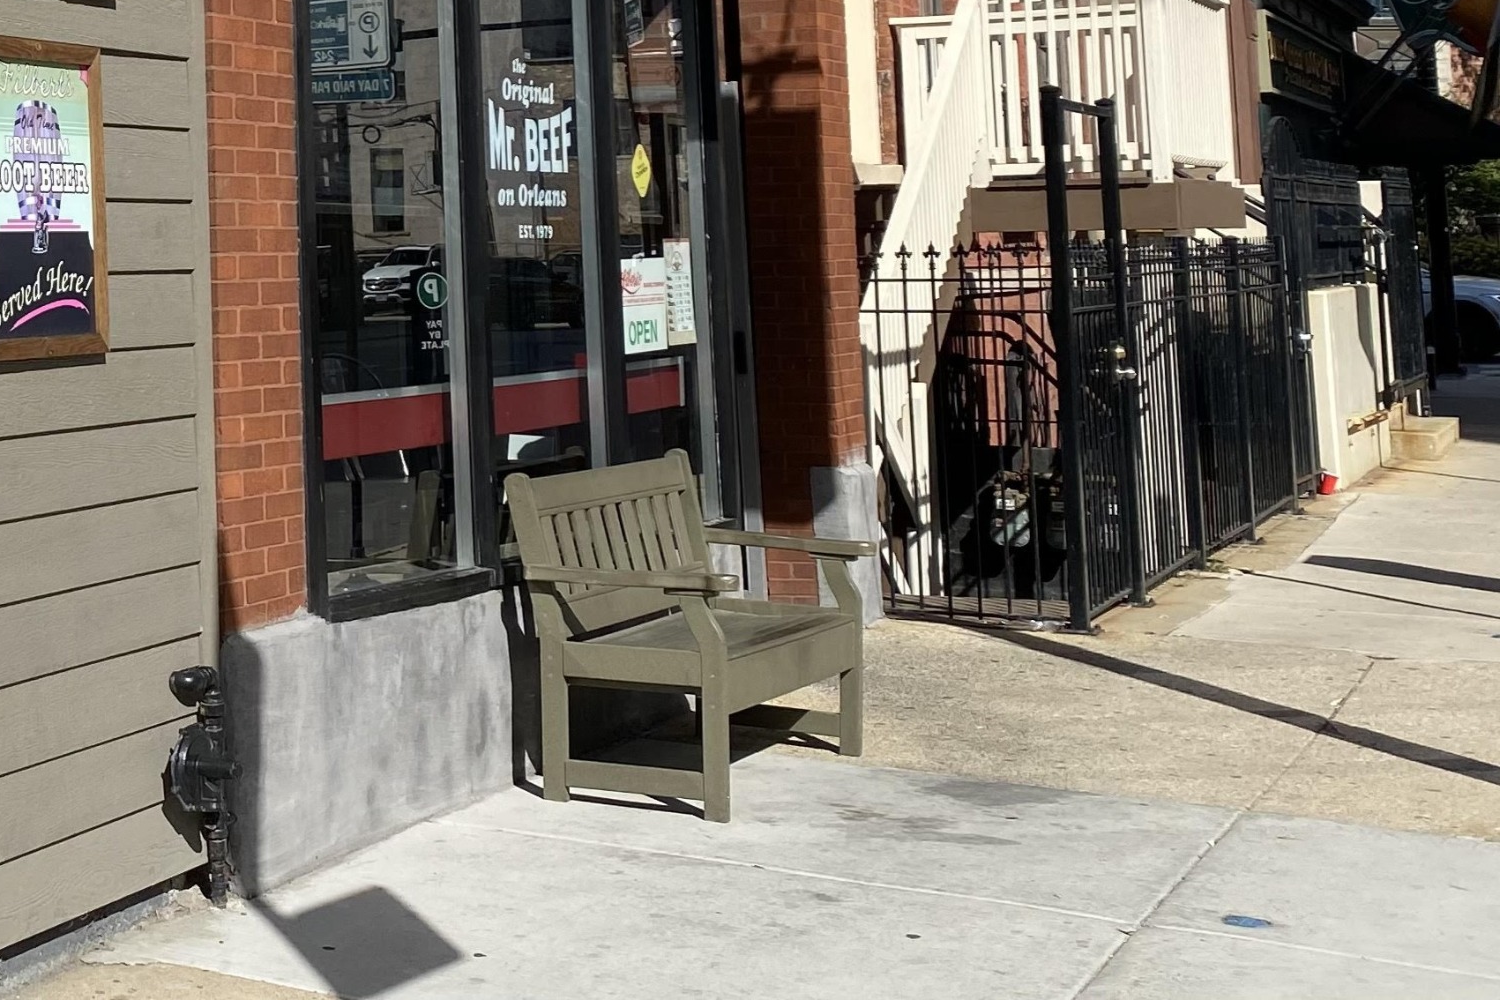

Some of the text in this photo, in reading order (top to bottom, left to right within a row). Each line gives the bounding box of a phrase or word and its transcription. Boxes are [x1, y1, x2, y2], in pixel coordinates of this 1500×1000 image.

[512, 58, 527, 74] the
[502, 77, 555, 108] Original
[5, 135, 71, 156] PREMIUM
[488, 98, 573, 173] Mr. BEEF
[39, 162, 90, 194] BEER
[498, 183, 567, 207] on Orleans
[518, 224, 553, 239] EST. 1979
[46, 260, 94, 298] Here!
[628, 319, 658, 346] OPEN
